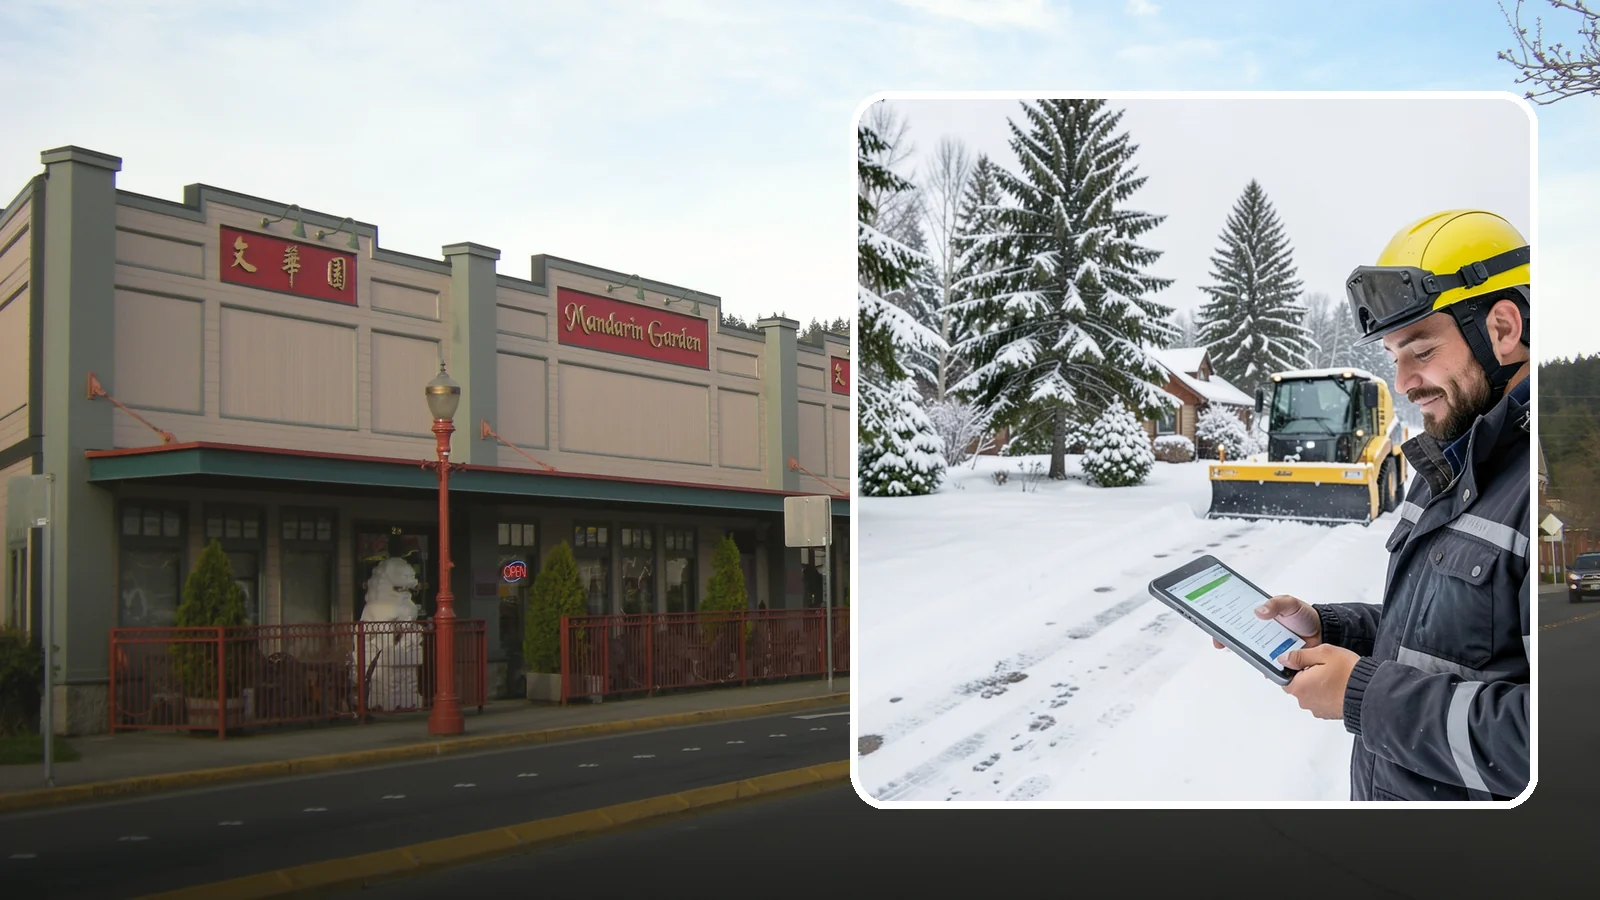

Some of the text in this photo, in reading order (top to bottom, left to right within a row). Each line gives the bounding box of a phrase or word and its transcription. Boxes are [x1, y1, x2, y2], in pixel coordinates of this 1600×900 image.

[564, 302, 702, 352] Mandarin Garden
[503, 565, 527, 578] OPEN
